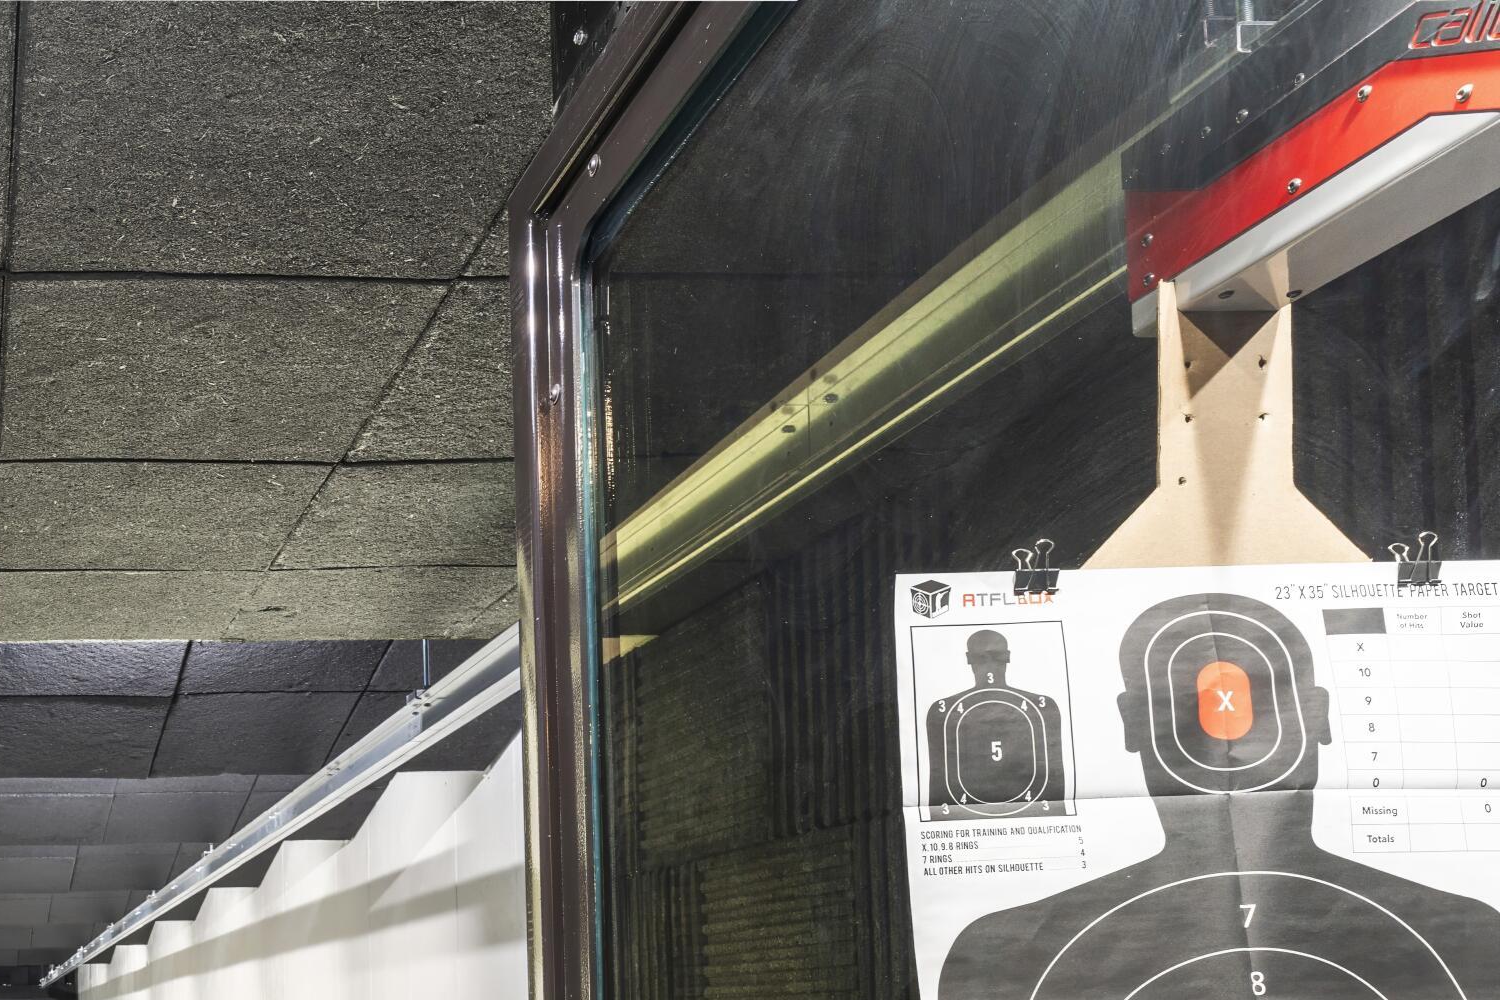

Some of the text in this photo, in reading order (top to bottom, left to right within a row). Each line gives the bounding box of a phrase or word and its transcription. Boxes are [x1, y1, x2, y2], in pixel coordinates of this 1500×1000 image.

[1331, 583, 1404, 598] SILHOUETTE
[1409, 583, 1449, 597] PAPER
[1453, 582, 1498, 596] TARGET
[1396, 613, 1428, 621] Number
[1462, 611, 1481, 619] Shot
[1460, 621, 1484, 629] Value
[1357, 642, 1364, 651] X
[987, 672, 994, 683] 3
[1359, 667, 1371, 677] 10
[938, 700, 946, 712] 3
[1020, 700, 1027, 711] 4
[1039, 696, 1046, 707] 3
[1216, 690, 1235, 711] X
[1365, 696, 1372, 705] 9
[956, 702, 964, 714] 4
[1368, 722, 1375, 732] 8
[991, 741, 1002, 761] 5
[1371, 751, 1378, 761] 7
[1372, 777, 1380, 788] 0
[1480, 777, 1487, 788] 0
[960, 793, 967, 804] 4
[1025, 790, 1032, 802] 4
[942, 803, 949, 815] 3
[1042, 800, 1050, 811] 3
[1484, 803, 1491, 813] 0
[1362, 806, 1398, 817] Missing
[920, 825, 1082, 840] SCORING FOR TRAINING AND QUALIFICATION
[1078, 836, 1083, 844] 5
[1367, 834, 1395, 843] Totals
[956, 841, 979, 850] RINGS
[1080, 848, 1086, 856] 4
[922, 854, 952, 864] 7 RINGS
[1081, 860, 1087, 869] 3
[924, 862, 1043, 876] ALL OTHER HITS ON SILHOUETTE
[1239, 903, 1256, 928] 7
[1250, 971, 1266, 996] 8
